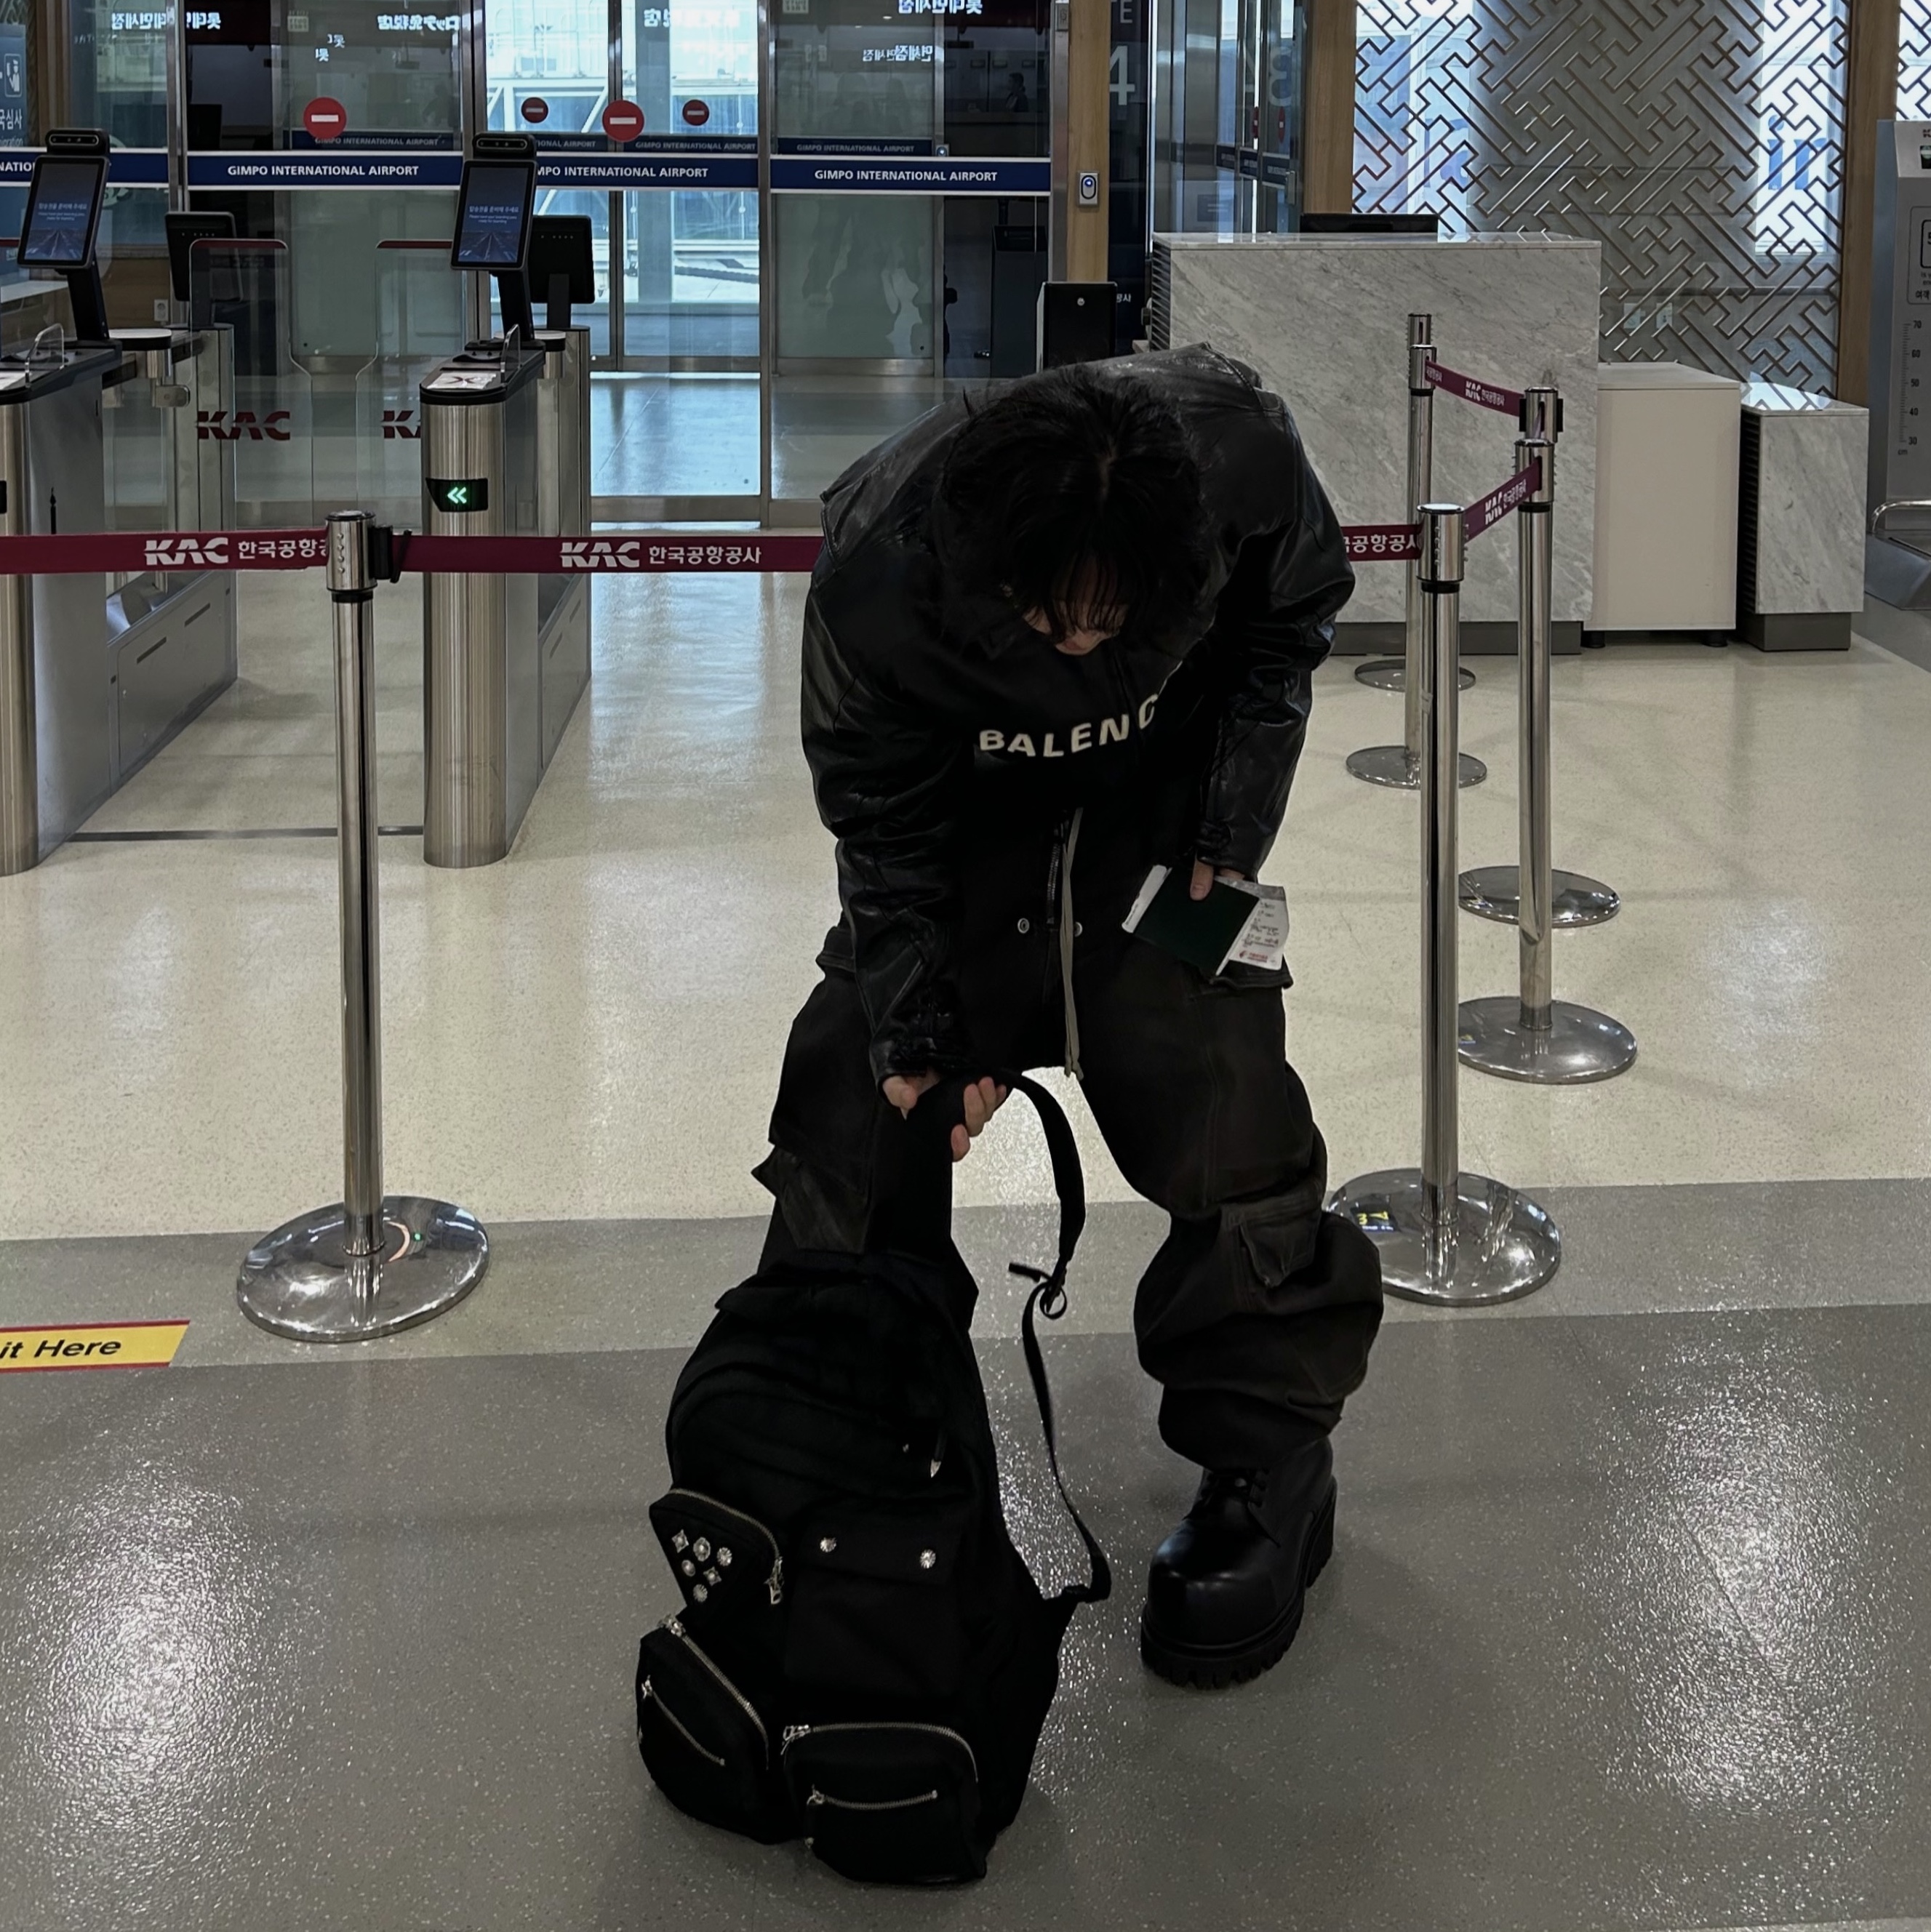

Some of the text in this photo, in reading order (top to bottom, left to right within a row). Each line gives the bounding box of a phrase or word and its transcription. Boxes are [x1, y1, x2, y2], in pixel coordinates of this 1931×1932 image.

[883, 145, 915, 153] AIRPORT
[0, 161, 35, 172] NATIO
[227, 164, 420, 177] GIMPO INTERNATIONAL AIRPORT
[564, 167, 657, 177] INTERNATIONAL
[659, 167, 709, 178] AIRPORT
[815, 169, 999, 182] GIMPO INTERNATIONAL AIRPORT
[1911, 379, 1920, 388] 50
[1909, 408, 1919, 417] 40
[196, 410, 291, 440] KAC
[380, 409, 421, 439] K
[1908, 437, 1918, 446] 30
[143, 537, 229, 566] KAC
[559, 541, 762, 568] KAC 한국공항공사
[33, 1339, 121, 1358] Here
